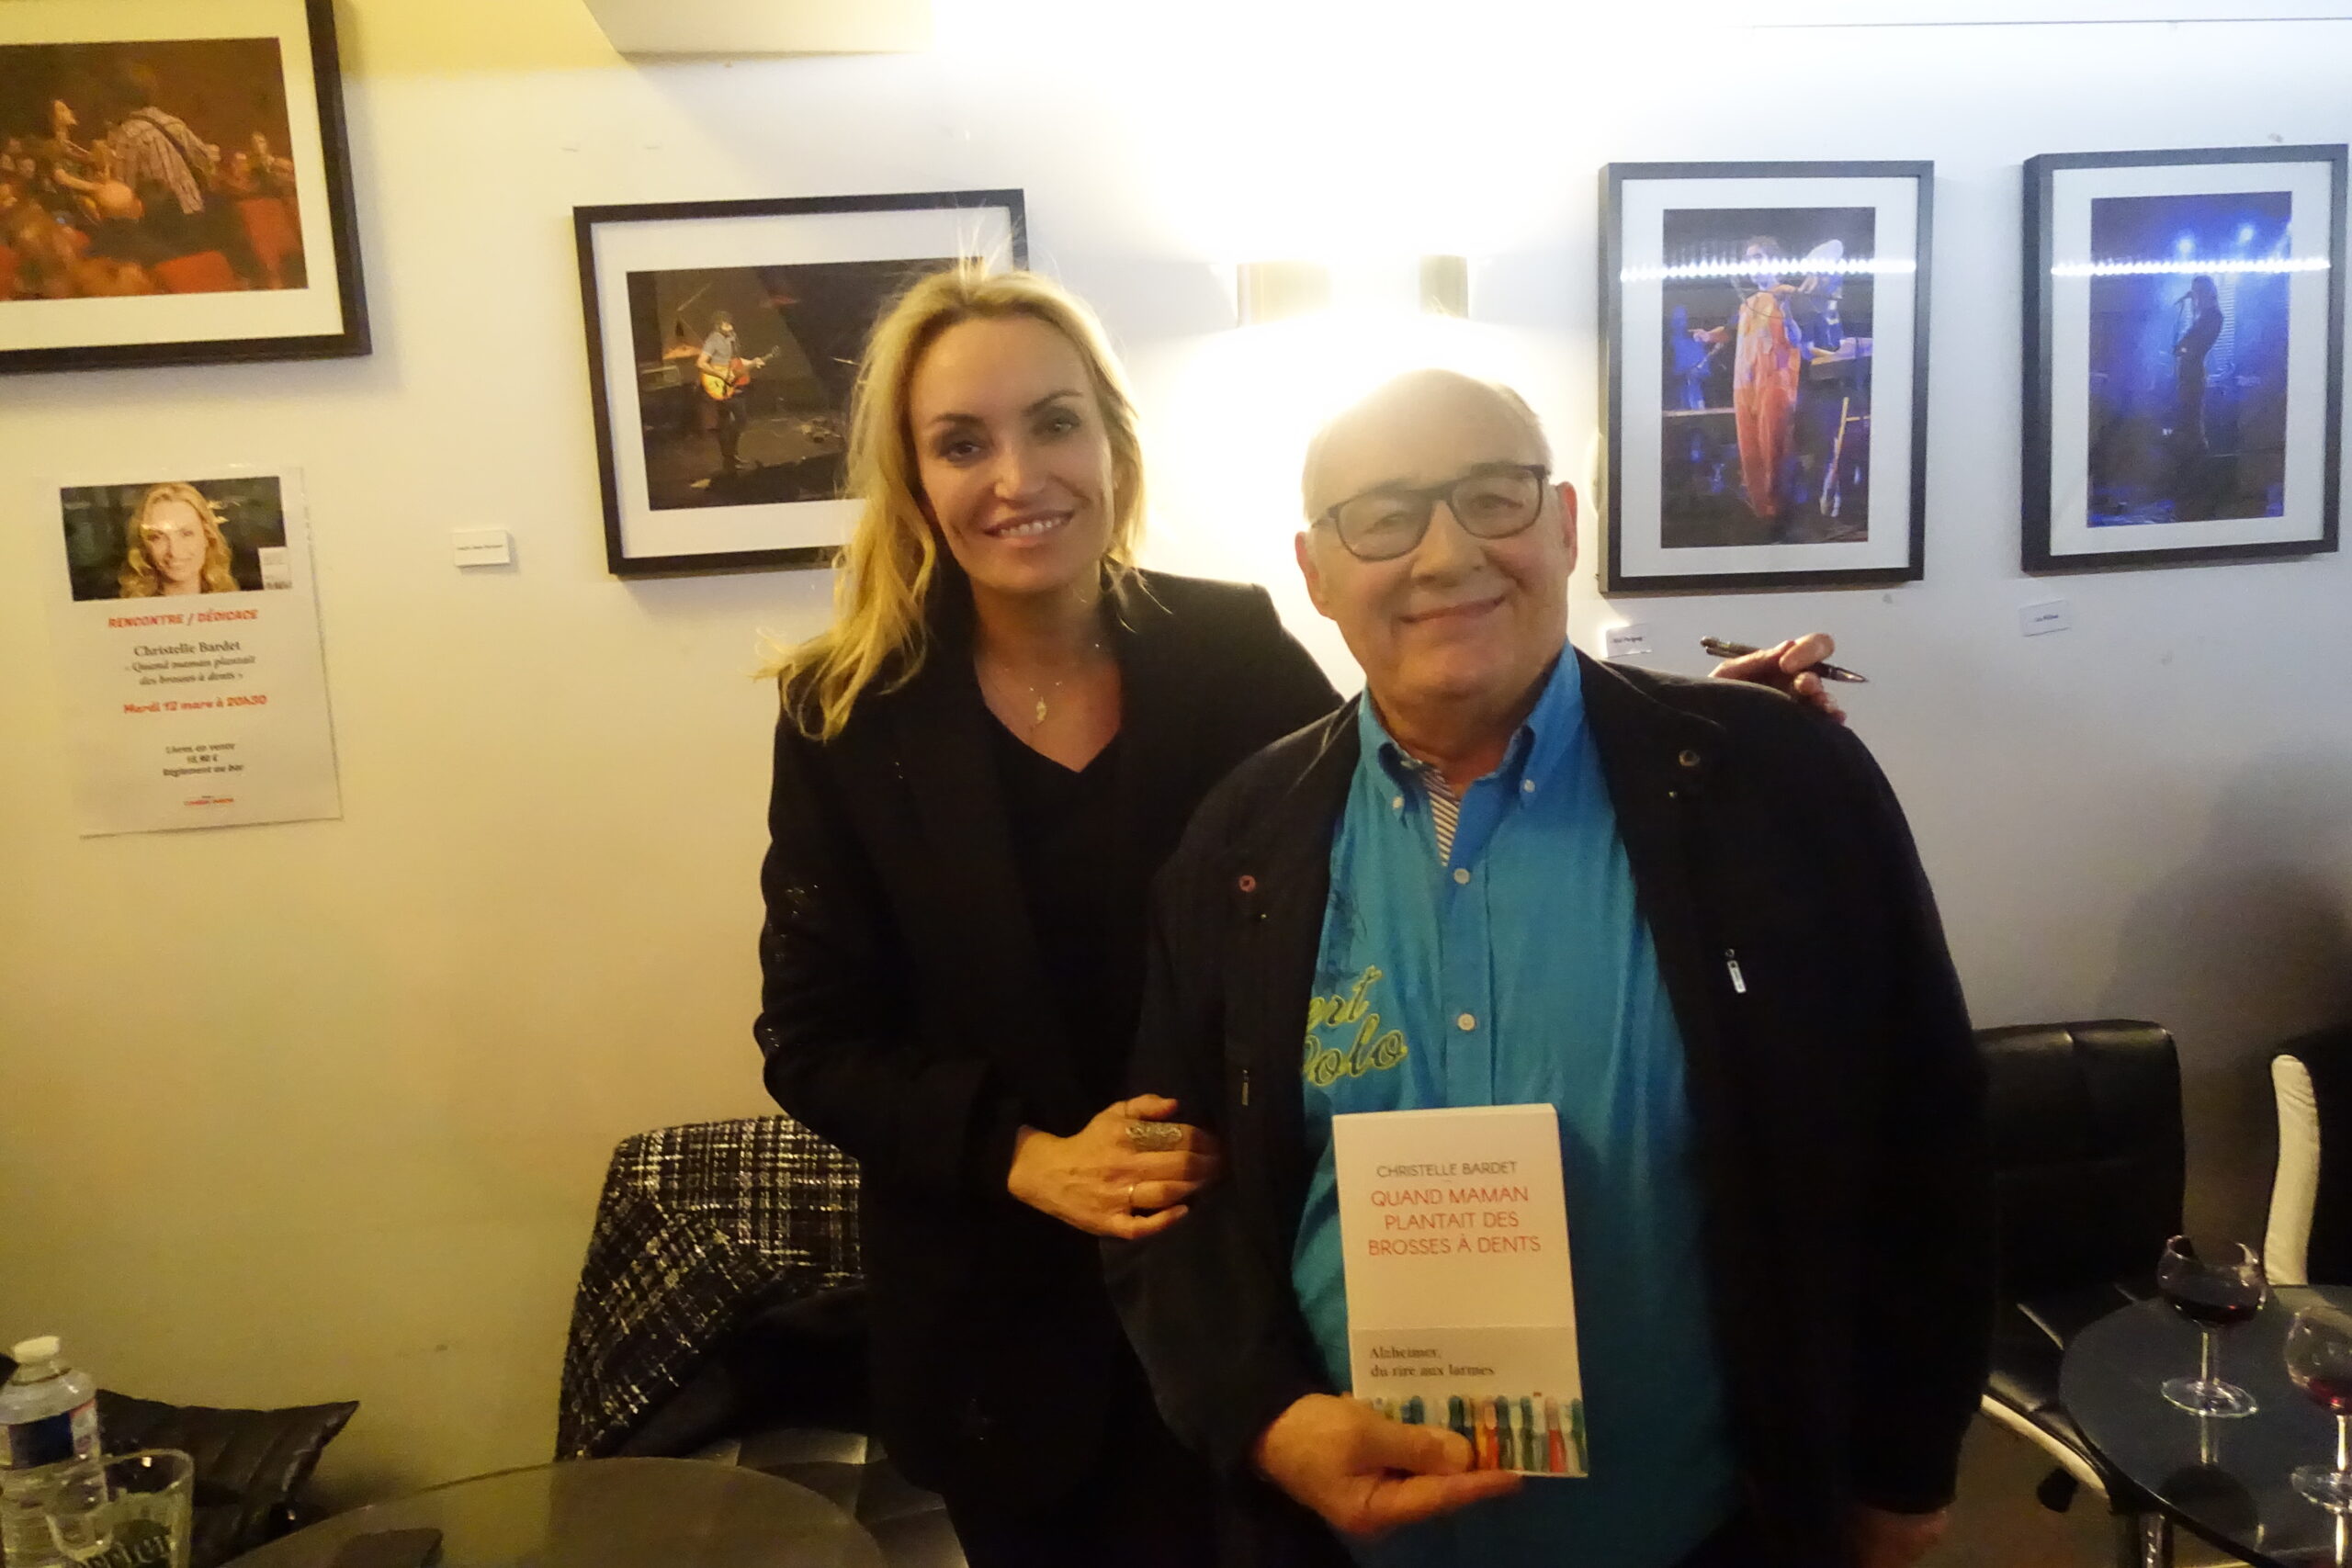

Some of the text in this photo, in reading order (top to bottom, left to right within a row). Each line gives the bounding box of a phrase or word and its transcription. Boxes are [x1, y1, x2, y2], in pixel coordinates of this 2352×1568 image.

[108, 615, 184, 628] RENCONTRE
[133, 640, 242, 657] Christelle Bardet
[131, 660, 169, 672] Quand
[123, 702, 161, 713] Mardi
[164, 701, 178, 711] 12
[180, 701, 213, 710] mars
[1376, 1160, 1518, 1178] CHRISTELLE BARDET
[1371, 1185, 1529, 1207] QUAND MAMAN
[1385, 1211, 1520, 1231] PLANTAIT DES
[1368, 1233, 1542, 1257] BROSSES À DENTS
[1371, 1362, 1496, 1378] du rire aux larmes
